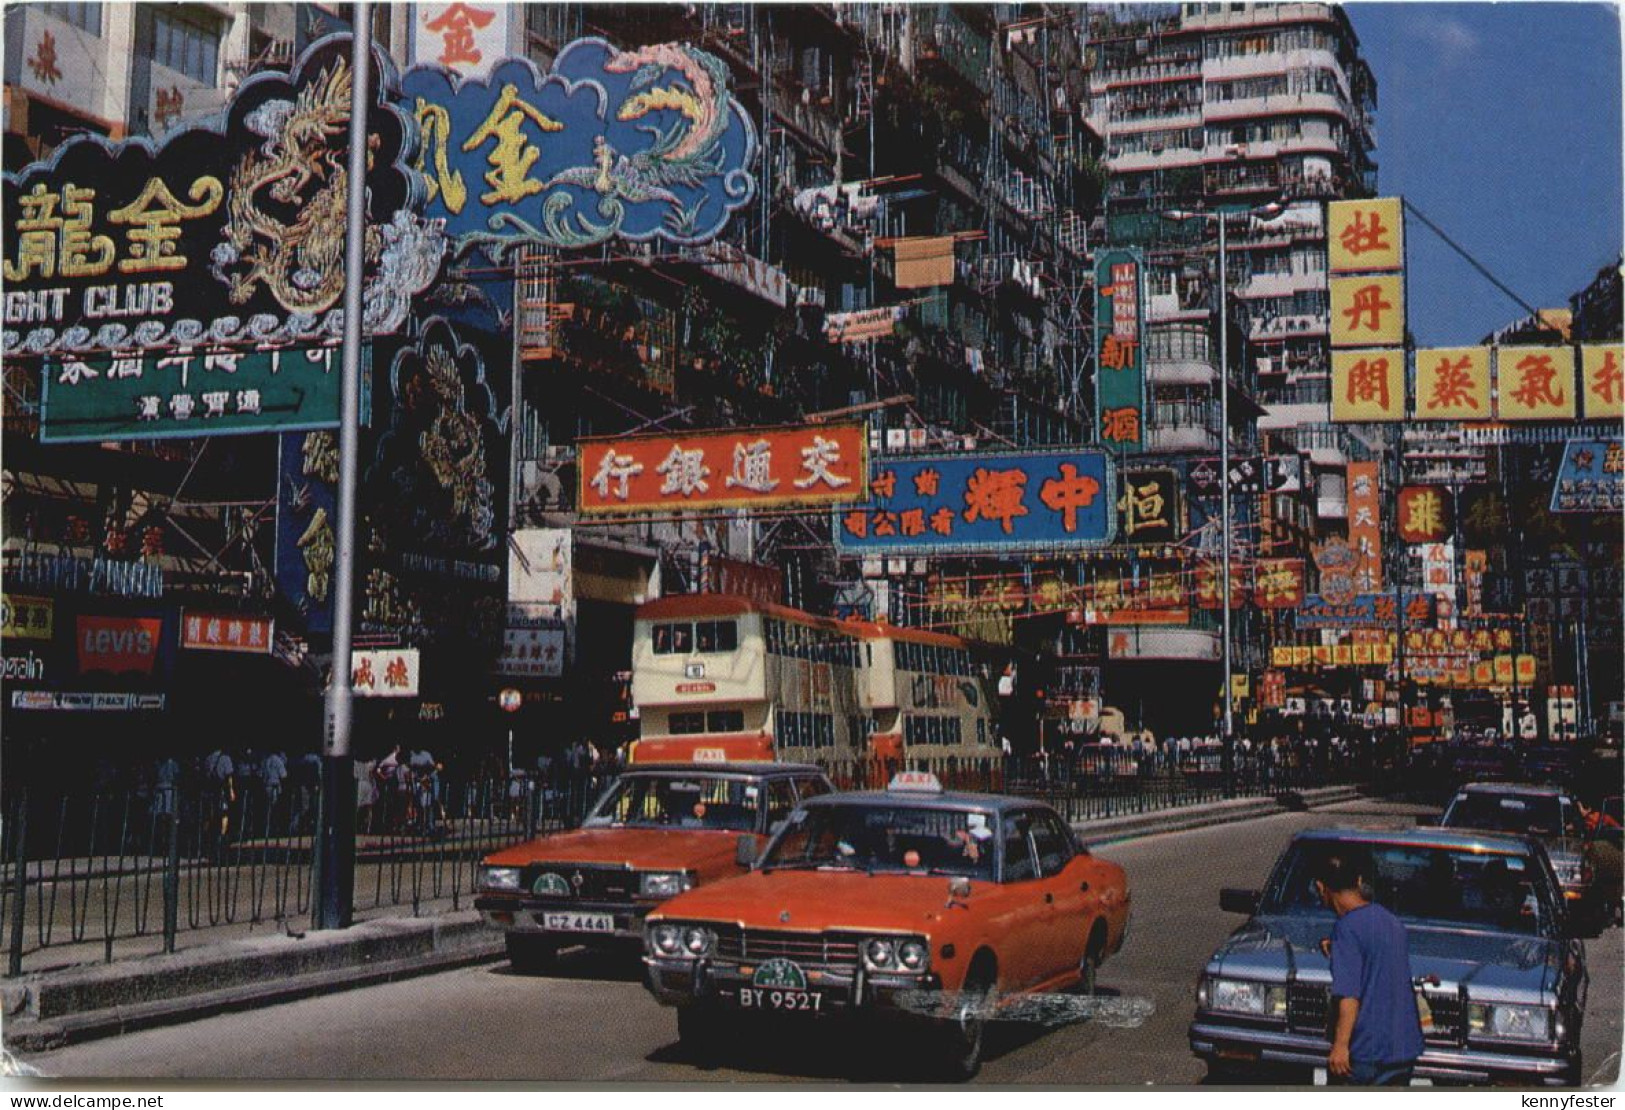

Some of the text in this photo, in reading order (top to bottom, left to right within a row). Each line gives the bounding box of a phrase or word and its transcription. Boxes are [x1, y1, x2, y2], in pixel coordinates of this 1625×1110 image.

[426, 3, 496, 66] 金
[84, 281, 174, 319] CLUB
[1339, 210, 1392, 411] 牡丹閣
[590, 435, 853, 501] 交通銀行
[963, 462, 1100, 534] 中輝
[696, 750, 724, 761] TAXI
[898, 773, 932, 784] TAXI
[548, 915, 610, 929] CZ 4441
[740, 988, 822, 1011] BY 9527
